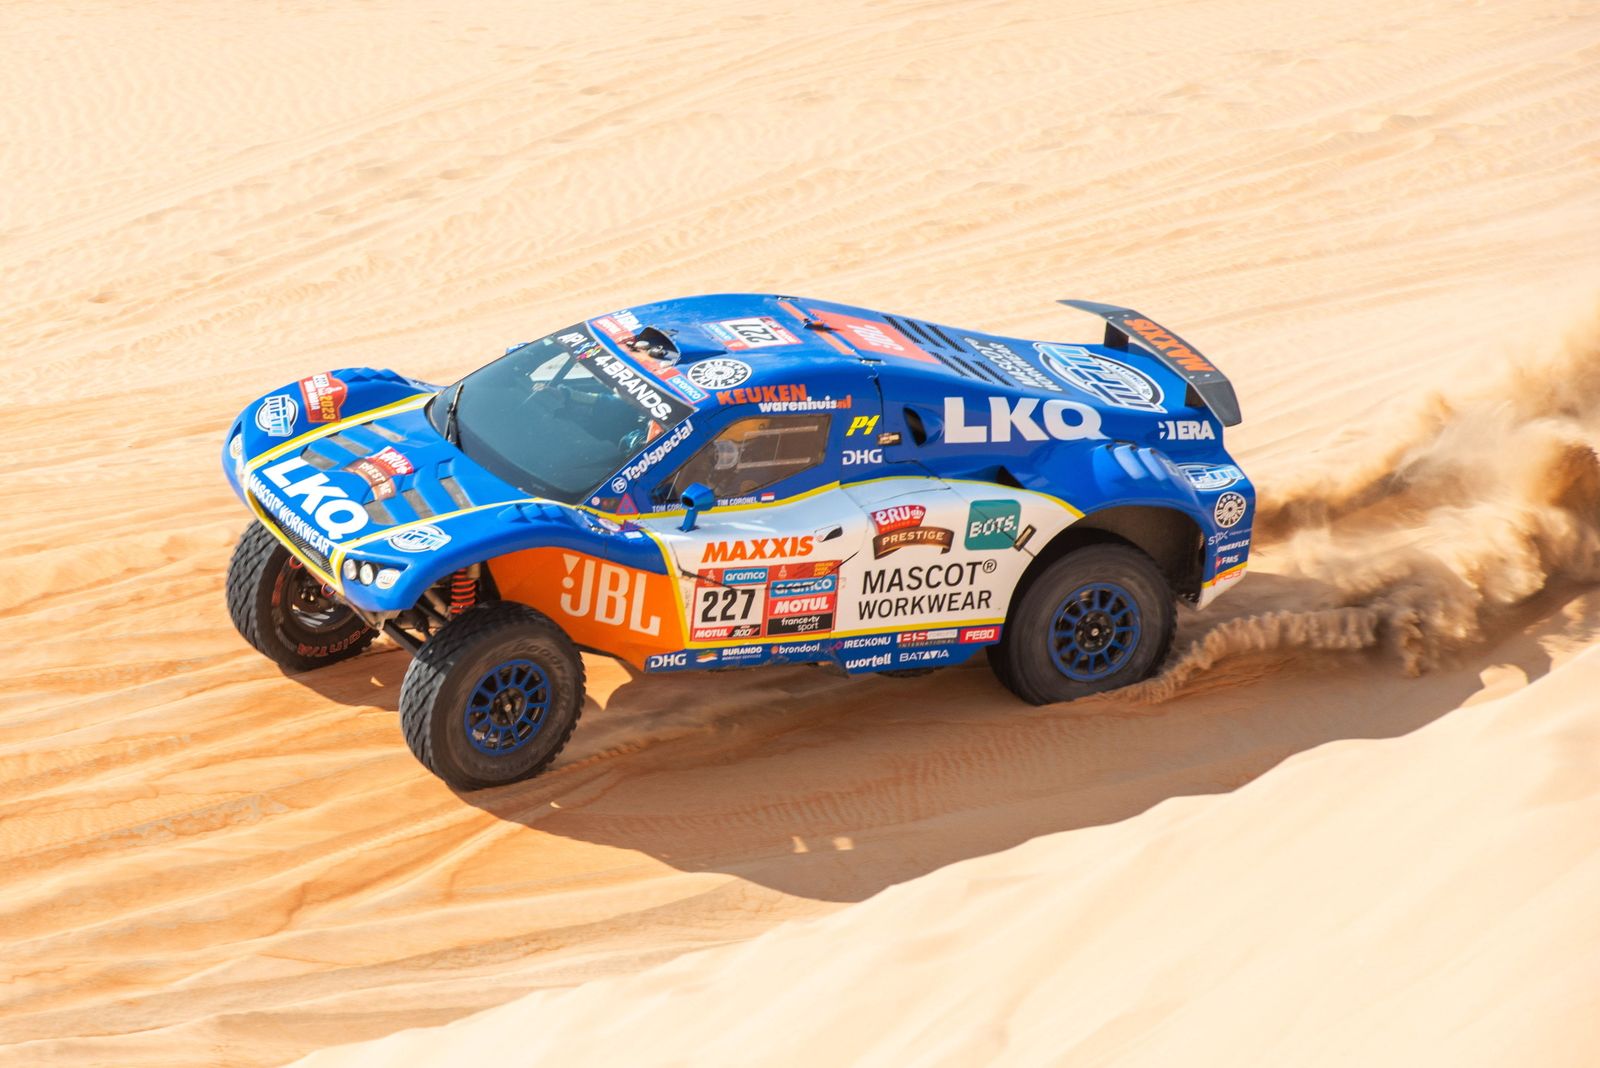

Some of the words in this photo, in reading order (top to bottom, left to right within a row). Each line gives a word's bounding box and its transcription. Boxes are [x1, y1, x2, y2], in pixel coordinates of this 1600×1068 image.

[729, 322, 779, 343] 227
[1123, 318, 1216, 372] MAXXIS
[671, 376, 702, 400] aramco
[716, 383, 807, 405] KEUKEN
[319, 394, 336, 421] 2023
[846, 415, 880, 437] P1
[944, 396, 1112, 444] LKQ
[621, 419, 694, 479] Toolspecial
[842, 449, 883, 465] DHG
[262, 456, 369, 540] LKQ
[717, 497, 731, 507] TIM
[733, 495, 757, 506] CORONEL
[652, 504, 666, 513] TOM
[279, 507, 330, 556] WORKWEAR
[882, 530, 946, 546] PRESTIGE
[701, 535, 814, 563] MAXXIS
[725, 569, 766, 582] aramco
[774, 578, 832, 595] aramco
[560, 559, 661, 637] JBL
[701, 588, 756, 623] 227
[774, 596, 829, 615] MOTUL
[858, 590, 992, 620] WORKWEAR
[694, 627, 729, 639] MOTUL
[797, 621, 819, 633] sport
[965, 629, 995, 641] FEBO
[843, 636, 891, 649] IRECKONU
[650, 653, 687, 668] DHG
[845, 652, 892, 669] wortell
[900, 649, 949, 662] BATAVIA
